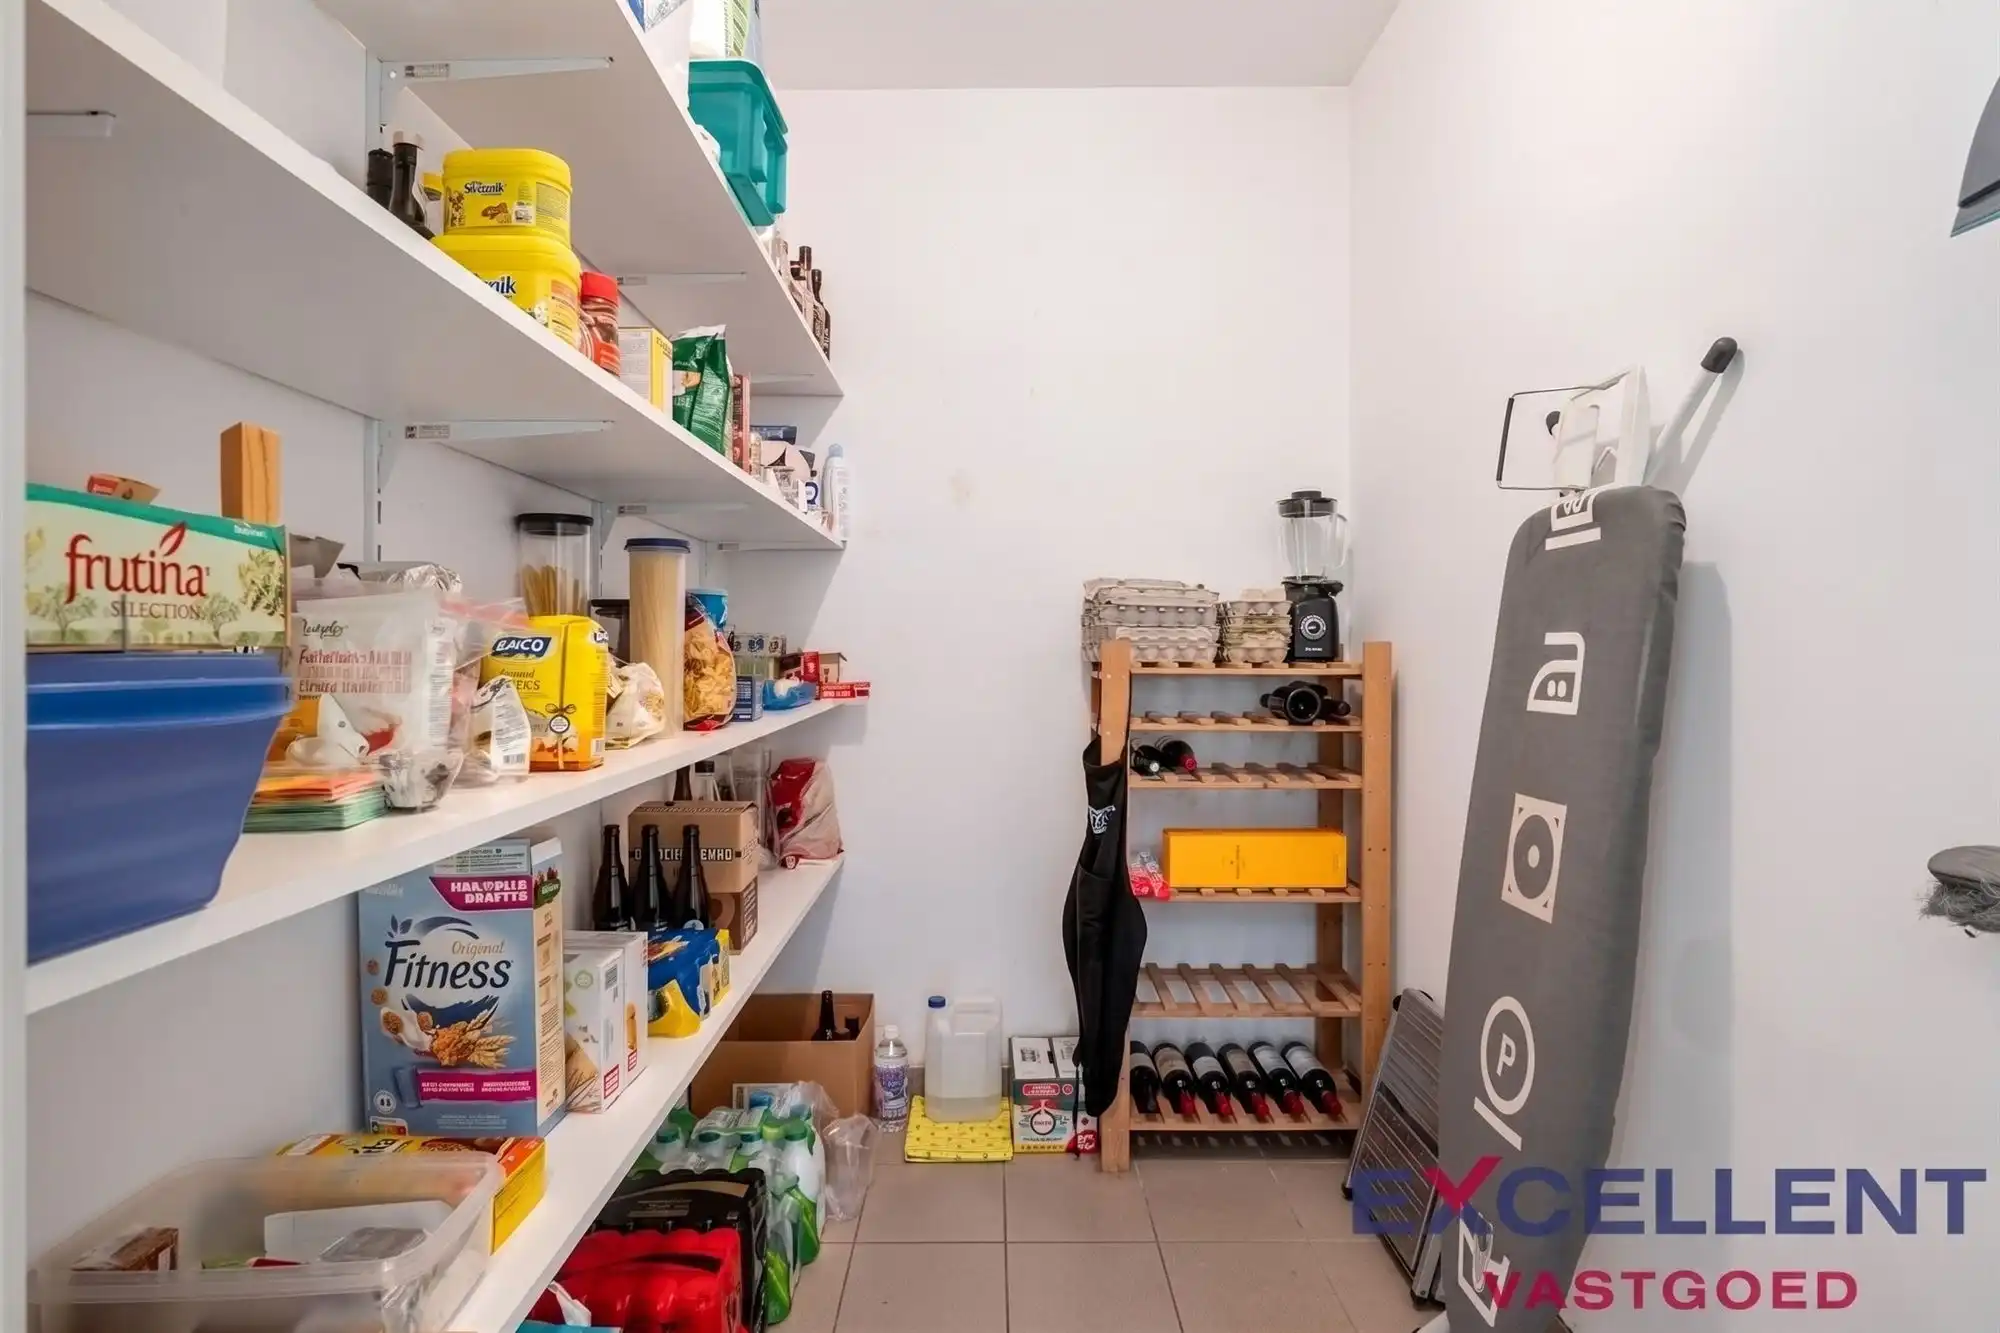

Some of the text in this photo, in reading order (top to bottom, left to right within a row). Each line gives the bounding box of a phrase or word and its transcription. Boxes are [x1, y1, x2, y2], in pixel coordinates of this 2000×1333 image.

[64, 533, 206, 605] frutina
[384, 940, 512, 989] Fitness
[452, 938, 506, 960] Original
